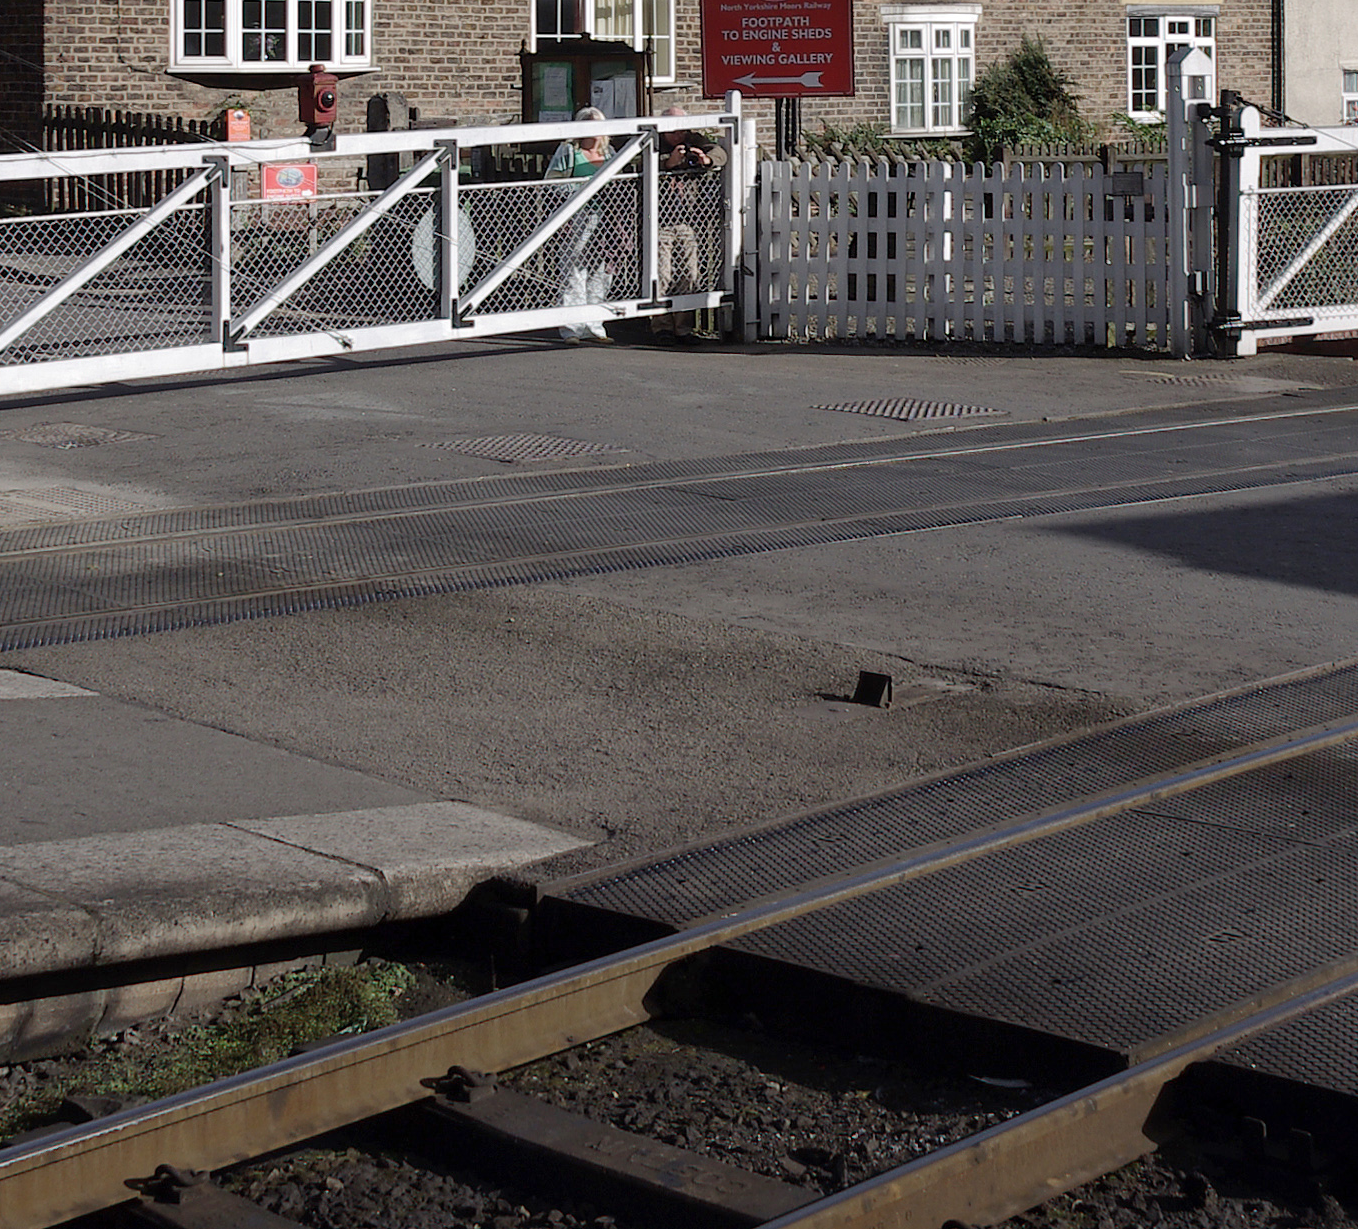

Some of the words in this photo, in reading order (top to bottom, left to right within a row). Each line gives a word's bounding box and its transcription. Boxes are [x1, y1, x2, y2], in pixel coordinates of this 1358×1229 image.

[804, 2, 831, 10] Railway
[742, 16, 810, 28] FOOTPATH
[722, 30, 739, 40] TO
[742, 29, 788, 40] ENGINE
[791, 28, 832, 39] SHEDS
[772, 42, 781, 52] &
[721, 55, 775, 65] VIEWING
[778, 53, 833, 64] GALLERY
